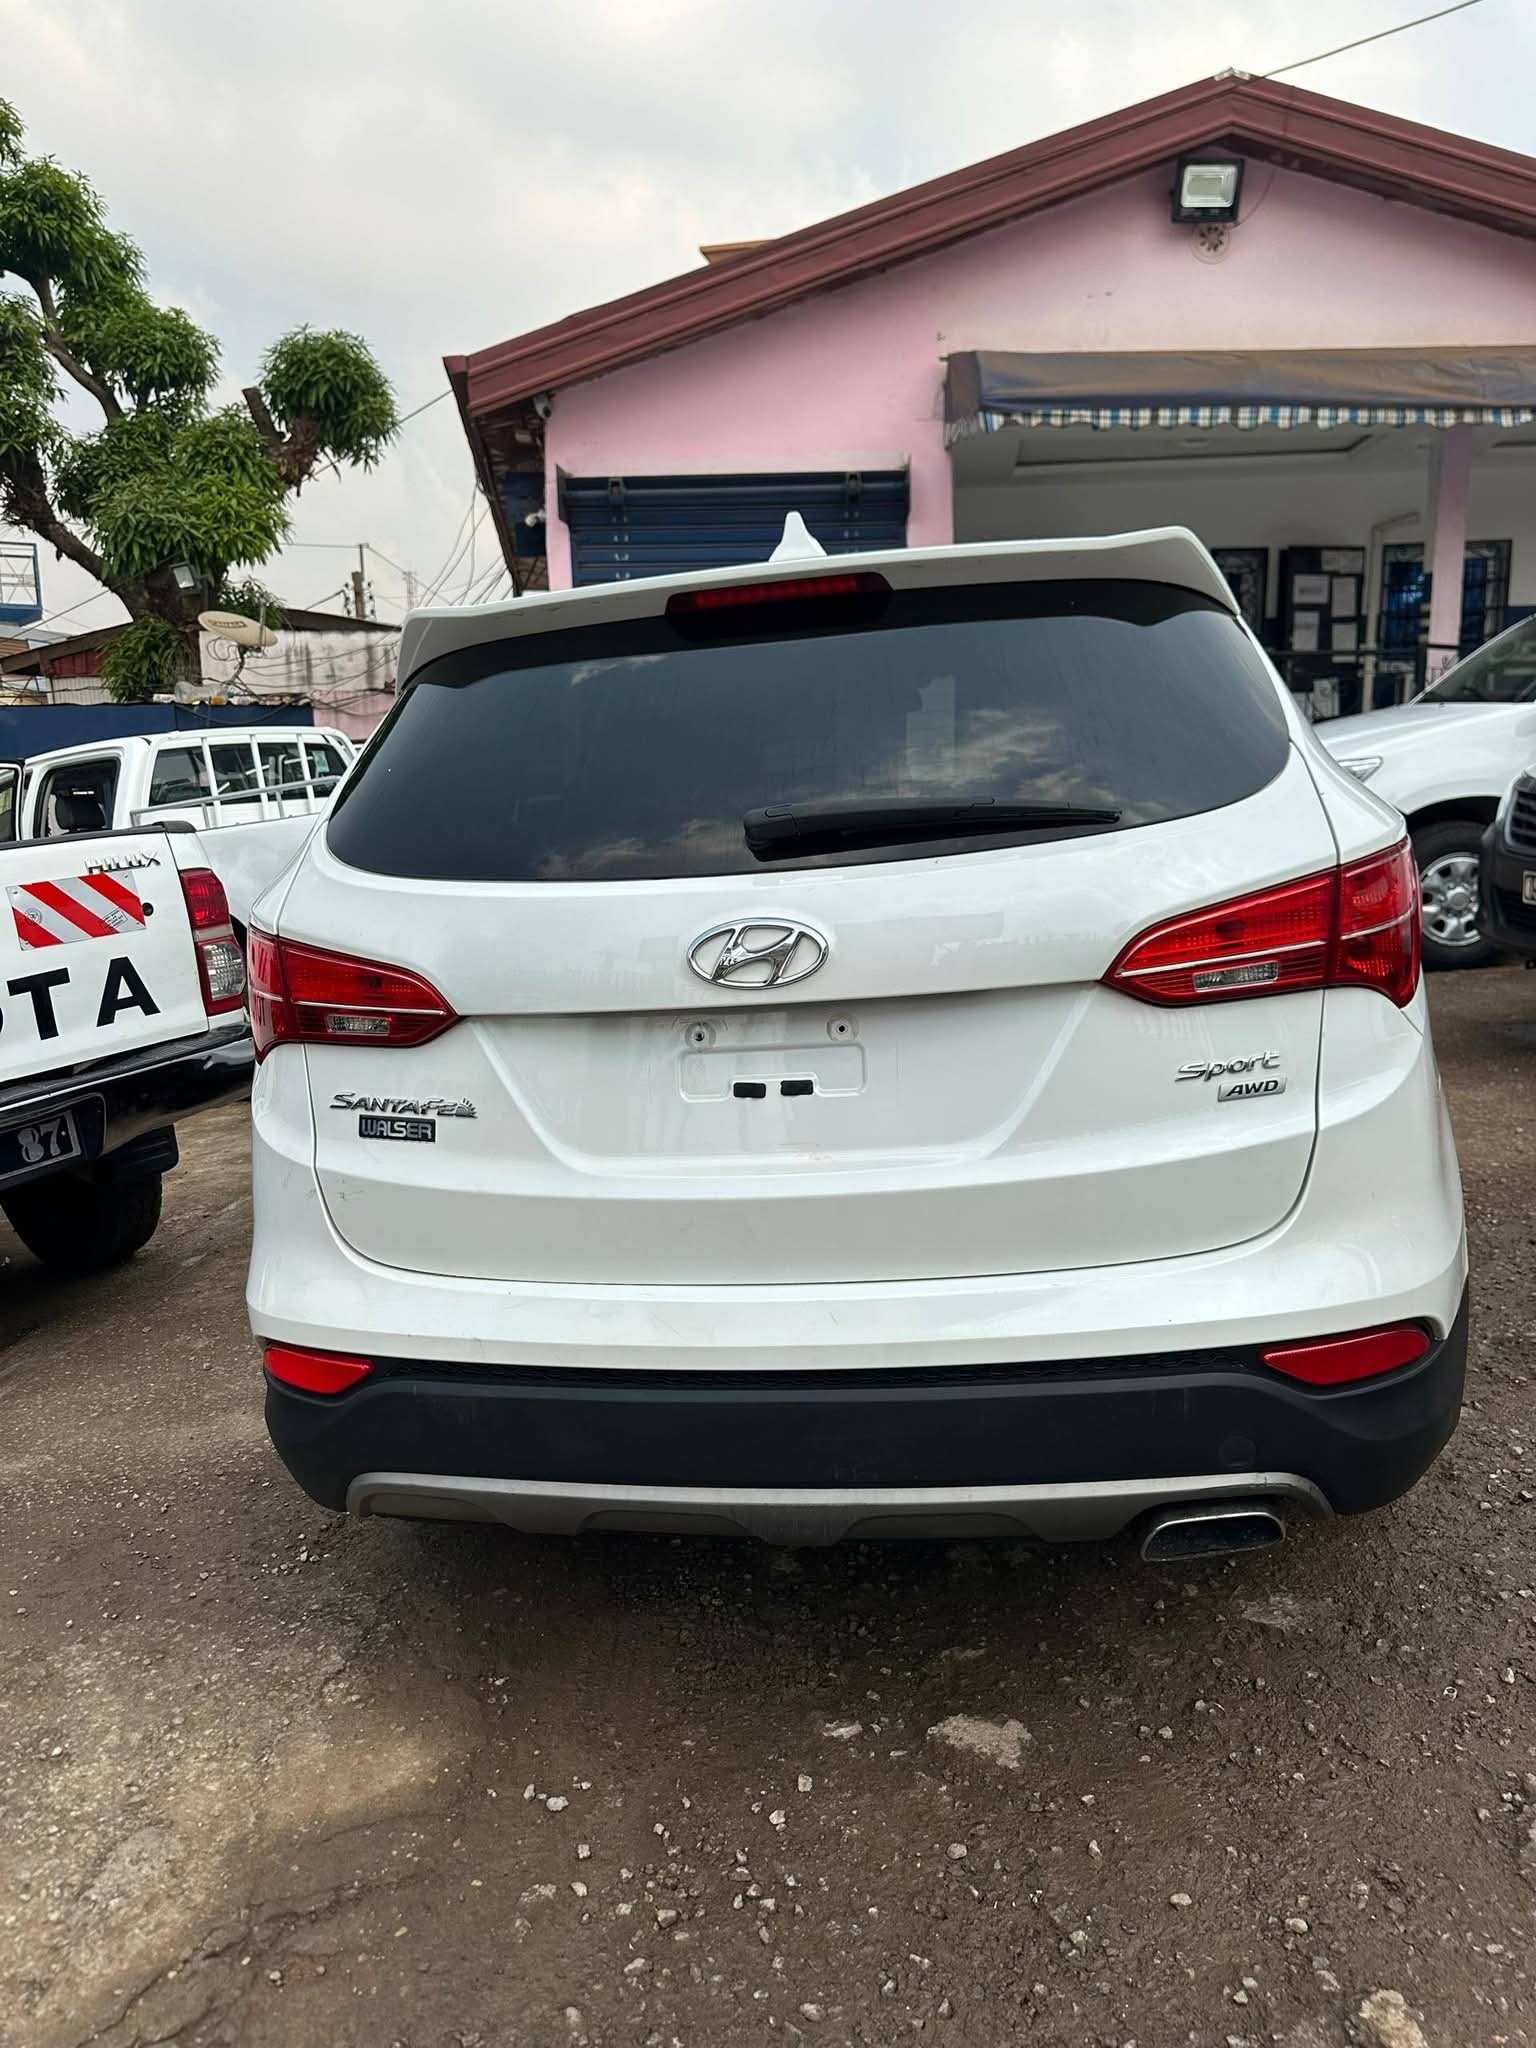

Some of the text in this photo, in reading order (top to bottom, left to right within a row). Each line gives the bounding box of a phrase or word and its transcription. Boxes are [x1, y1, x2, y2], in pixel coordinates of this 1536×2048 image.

[0, 956, 161, 1041] TA
[1174, 1050, 1280, 1082] Sport
[1226, 1079, 1279, 1097] AWD
[18, 1118, 61, 1163] 87
[361, 1118, 433, 1140] WALSER
